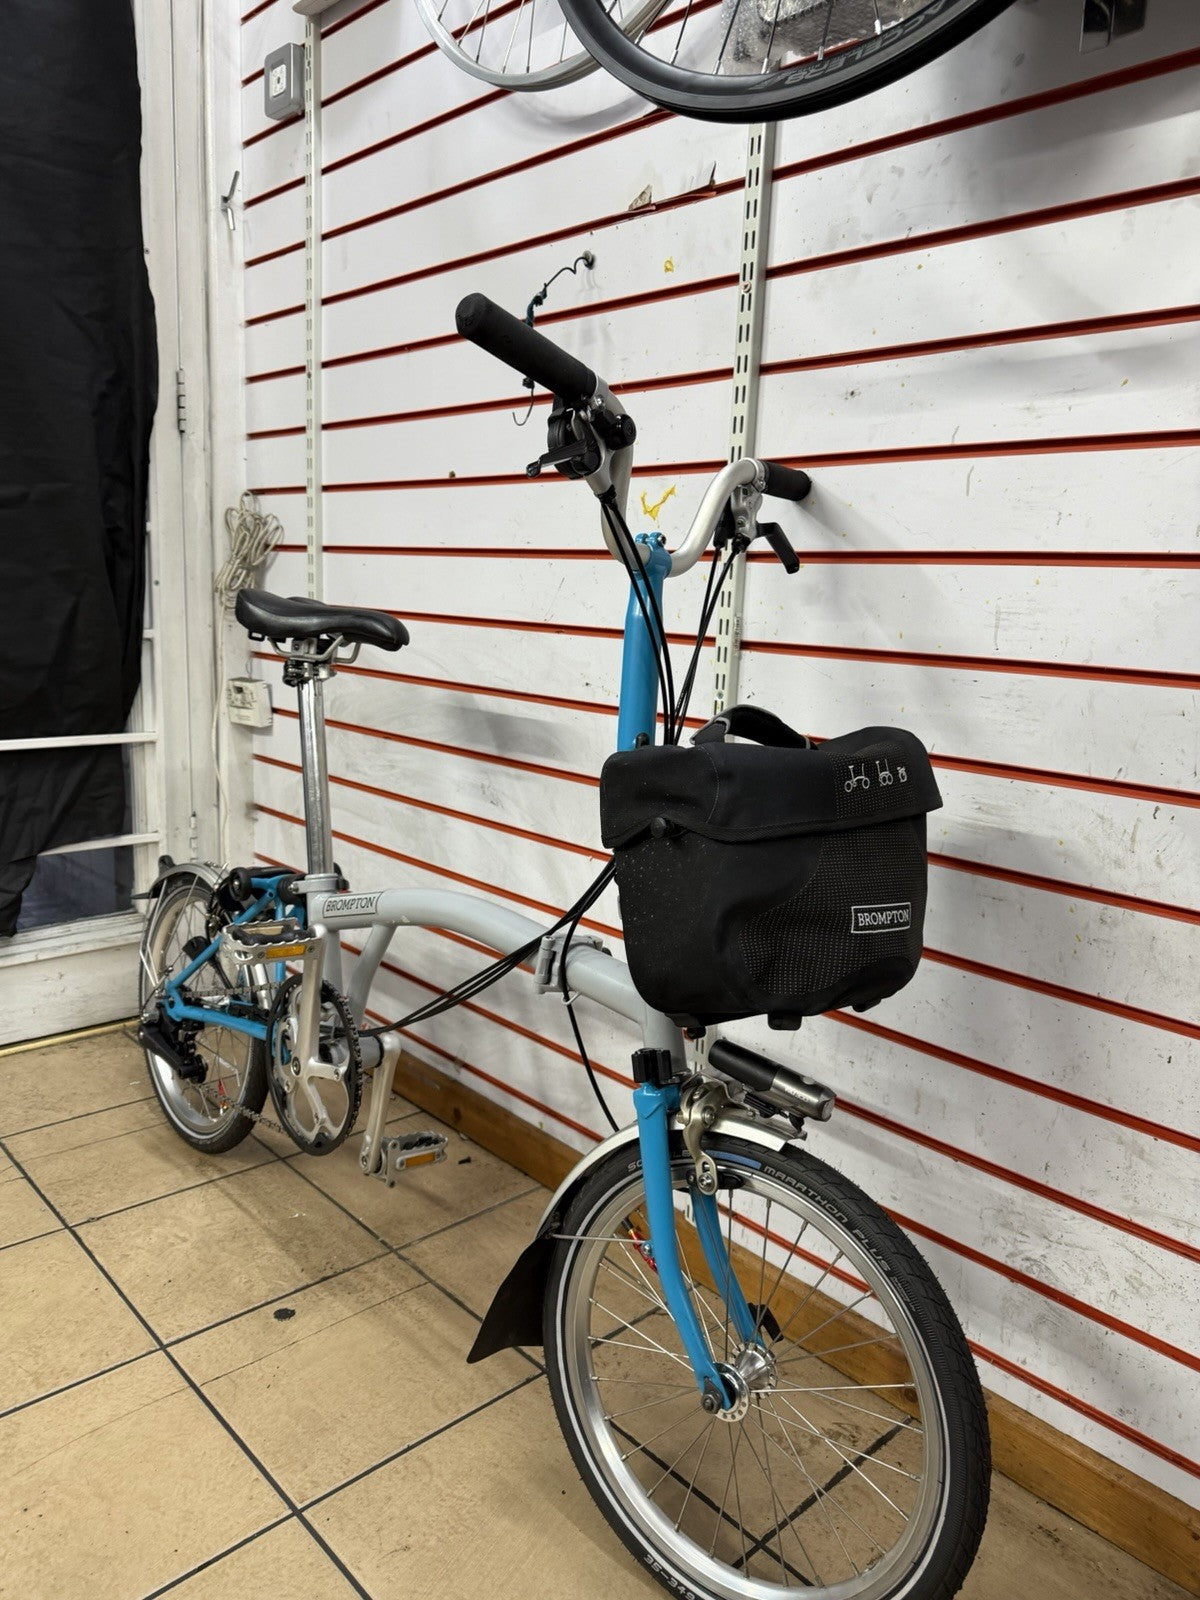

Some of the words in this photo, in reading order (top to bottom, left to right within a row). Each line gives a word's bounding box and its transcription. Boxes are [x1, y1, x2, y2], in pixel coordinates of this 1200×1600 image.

[326, 896, 376, 912] BROMPTON
[857, 909, 909, 926] BROMPTON
[763, 1165, 848, 1223] MARATHON
[852, 1229, 891, 1272] PLUS
